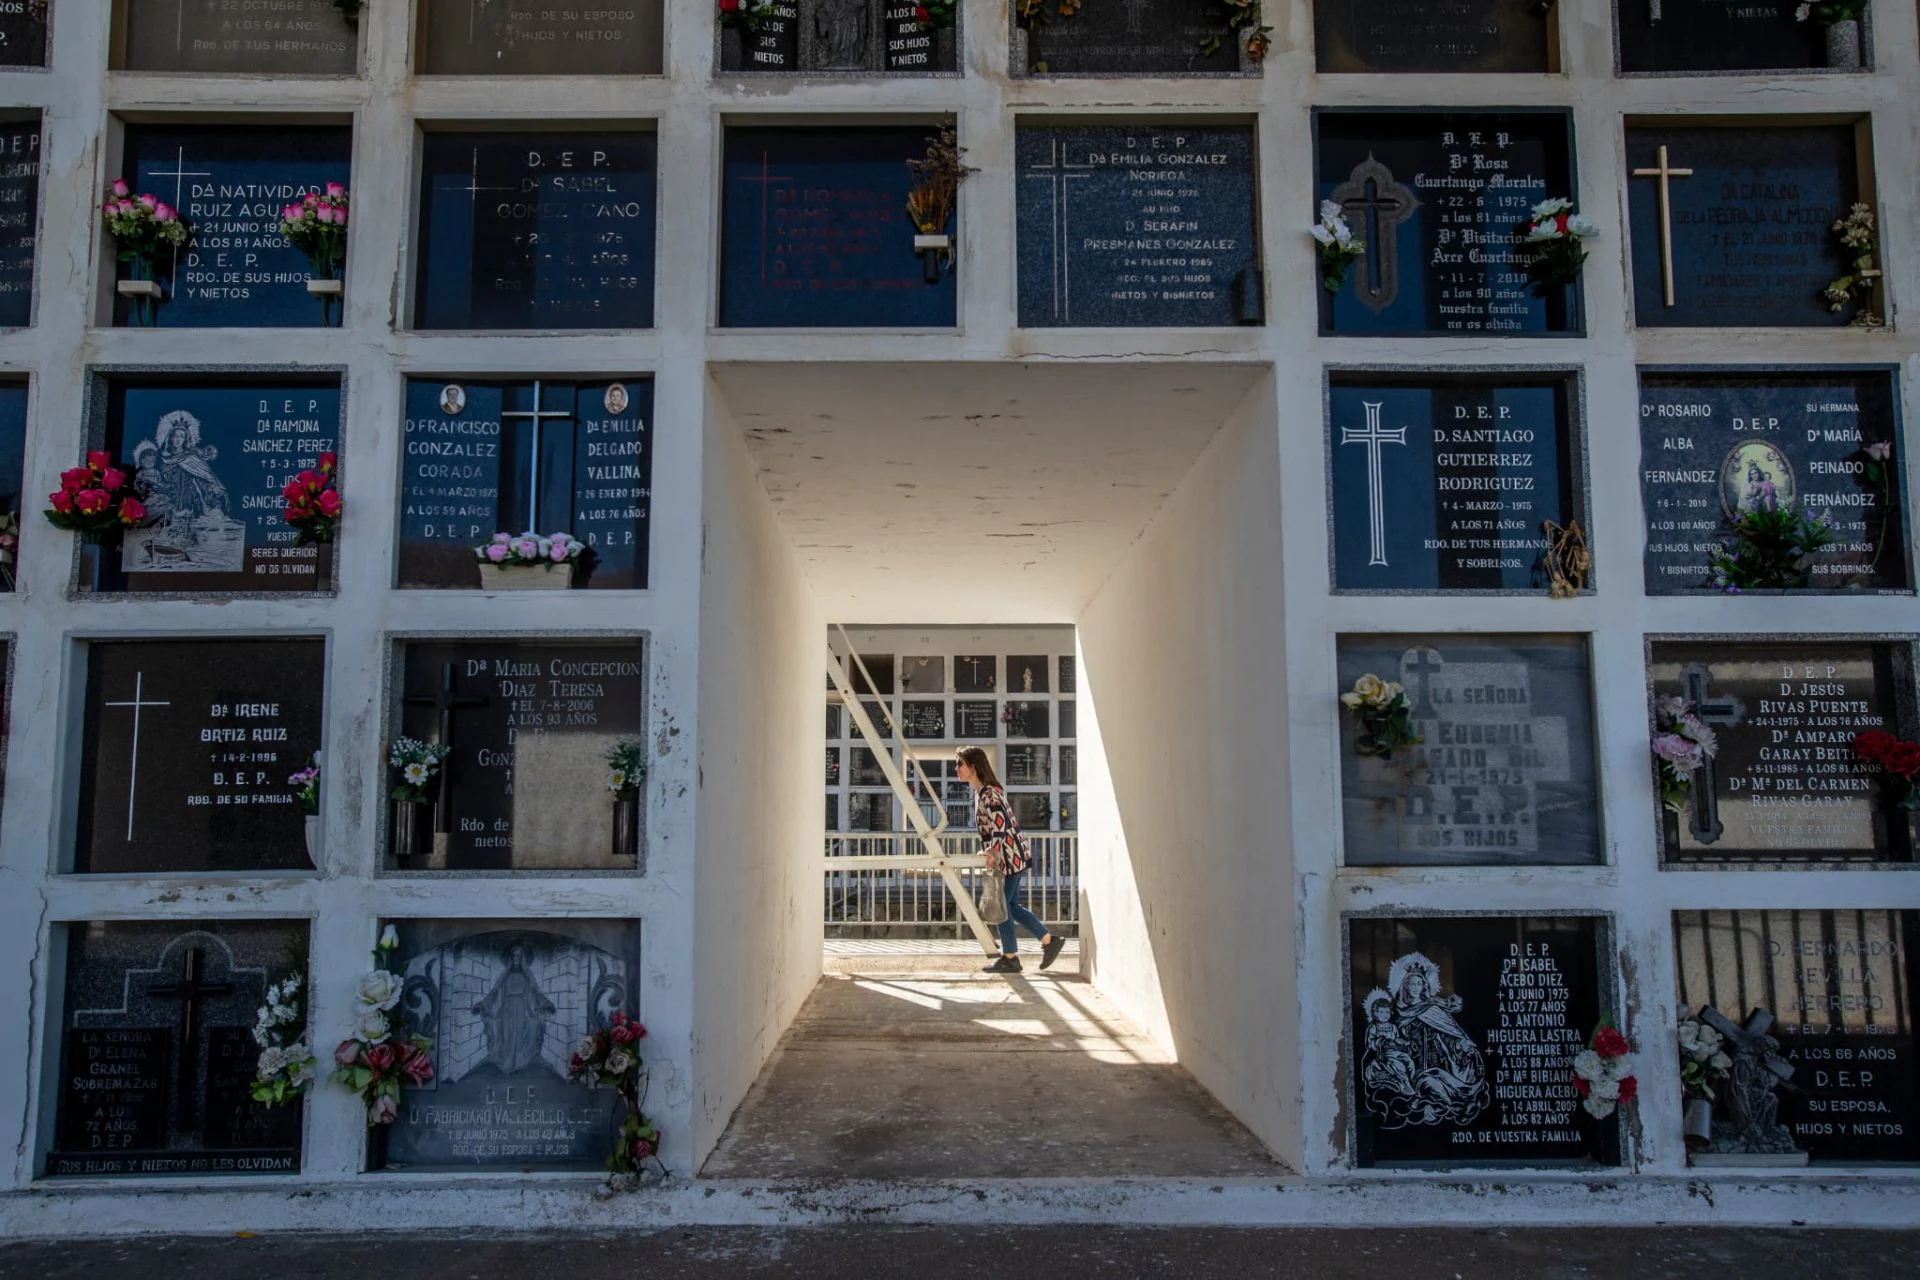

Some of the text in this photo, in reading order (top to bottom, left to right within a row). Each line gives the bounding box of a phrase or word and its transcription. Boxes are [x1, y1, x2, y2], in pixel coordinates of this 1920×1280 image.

[541, 11, 634, 20] DE SU ESPOSO
[522, 31, 622, 40] HIJOS Y NIETOS
[274, 41, 346, 51] HERMANOS
[889, 37, 930, 50] SUS HIJOS
[754, 52, 784, 64] NIETOS
[891, 53, 927, 65] Y NIETOS
[529, 152, 610, 167] D. P.
[1111, 154, 1227, 164] EMILIA GONZALEZ
[1473, 154, 1508, 169] Rosa
[191, 205, 232, 216] RUIZ
[204, 224, 258, 233] 21 JUNIO
[1144, 221, 1197, 231] SERAFIN
[189, 235, 292, 248] A LOS 81 AÑOS
[1084, 239, 1235, 249] PRESMANES GONZALEZ
[187, 273, 311, 282] RDO. DE SUS HIJOS
[187, 288, 250, 298] Y NIETOS
[1440, 303, 1528, 314] vuestra familia
[260, 400, 319, 413] D. E. P.
[1455, 406, 1511, 418] D. E. P.
[1659, 405, 1711, 417] ROSARIO
[1806, 403, 1859, 412] SU HERMANA
[419, 420, 500, 435] FRANCISCO
[603, 419, 644, 433] EMILIA
[1733, 418, 1780, 430] D. E. P.
[1434, 430, 1534, 442] D. SANTIAGO
[243, 440, 333, 452] SANCHEZ PEREZ
[408, 442, 497, 457] GONZALEZ
[588, 442, 642, 456] DELGADO
[1663, 438, 1694, 450] ALBA
[1437, 454, 1533, 466] GUTIERREZ
[419, 465, 483, 478] CORADA
[588, 465, 640, 479] VALLINA
[1810, 462, 1863, 473] PEINADO
[1438, 478, 1534, 490] RODRIGUEZ
[1804, 491, 1875, 506] FERNÁNDEZ
[579, 507, 645, 520] A LOS 76 AÑOS
[1451, 519, 1525, 529] A LOS 71 AÑOS
[1424, 540, 1554, 549] RDO. DE TUS HERMANOS
[256, 565, 314, 573] NO OS OLVIDAN
[1457, 559, 1523, 567] Y SOBRINOS.
[1433, 685, 1526, 704] LA SEÑORA
[520, 700, 594, 711] EL 7-8-2006
[1760, 701, 1868, 713] RIVAS PUENTE
[508, 712, 597, 725] A LOS 93 AÑOS
[201, 728, 287, 742] ORTIZ RUIZ
[1760, 748, 1811, 760] GARAY
[188, 795, 292, 805] RDO. DE SU FAMILIA
[1464, 830, 1518, 846] HIJOS
[1511, 944, 1548, 955] D. E. P.
[1520, 959, 1557, 972] ISABEL
[1500, 974, 1563, 987] ACEBO DIEZ
[1508, 988, 1569, 999] 8 JUNIO 1975
[1516, 1015, 1565, 1026] ANTONIO
[1488, 1029, 1580, 1042] HIGUERA LASTRA
[1506, 1045, 1561, 1055] SEPTIEMBRE
[1790, 1047, 1896, 1059] A LOS 66 AÑOS
[90, 1063, 140, 1076] GRANEL
[1816, 1072, 1872, 1087] D. E. P.
[1496, 1086, 1578, 1098] HIGUERA ACEBO
[1526, 1102, 1576, 1112] ABRIL 2009
[1809, 1101, 1825, 1111] SU
[426, 1108, 491, 1125] FABRICIANO
[1502, 1111, 1570, 1124] A LOS 82 AÑOS
[463, 1130, 486, 1140] JUNIO
[1796, 1124, 1903, 1134] HIJOS Y NIETOS
[1452, 1131, 1581, 1143] RDO. DE VUESTRA FAMILIA
[58, 1157, 291, 1172] SUS HIJOS Y NIETOS NO LES OLVIDAN
